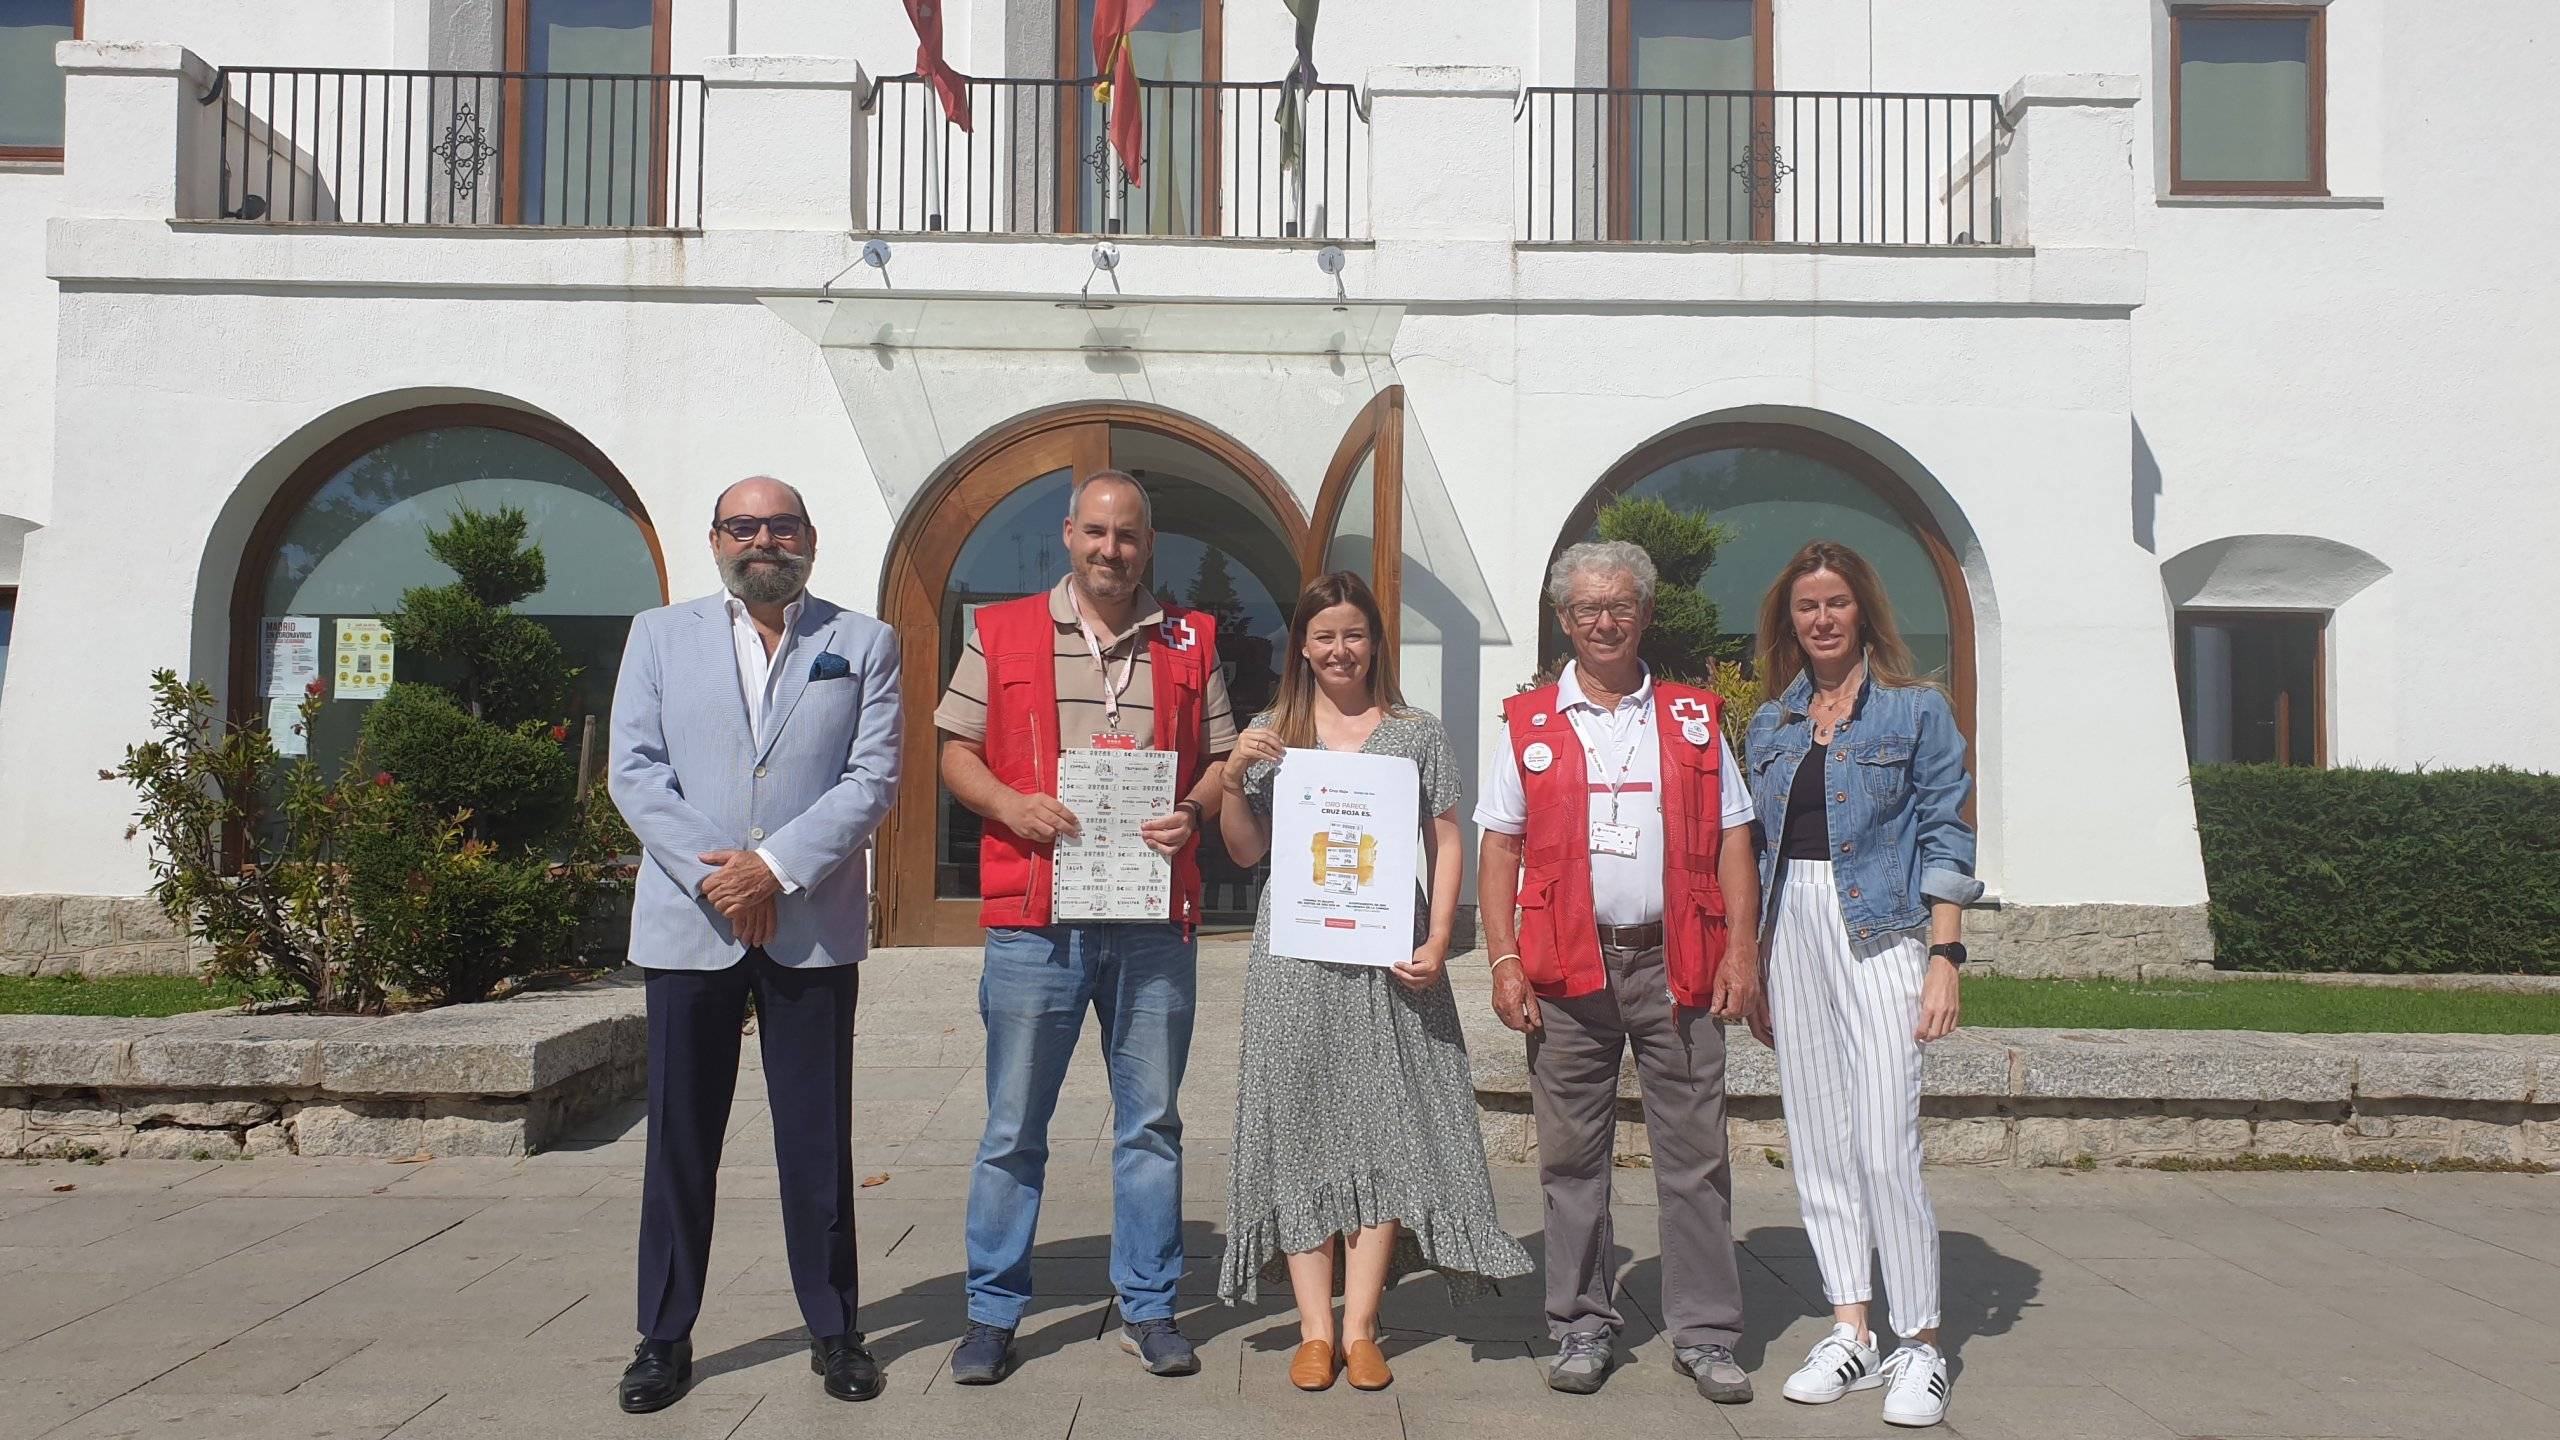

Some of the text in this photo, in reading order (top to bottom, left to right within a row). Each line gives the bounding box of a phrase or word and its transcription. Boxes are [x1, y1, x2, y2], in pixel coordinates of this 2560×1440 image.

[266, 622, 296, 631] MADRID
[275, 631, 312, 639] CORONAVIRUS
[1341, 802, 1369, 811] PARECE,
